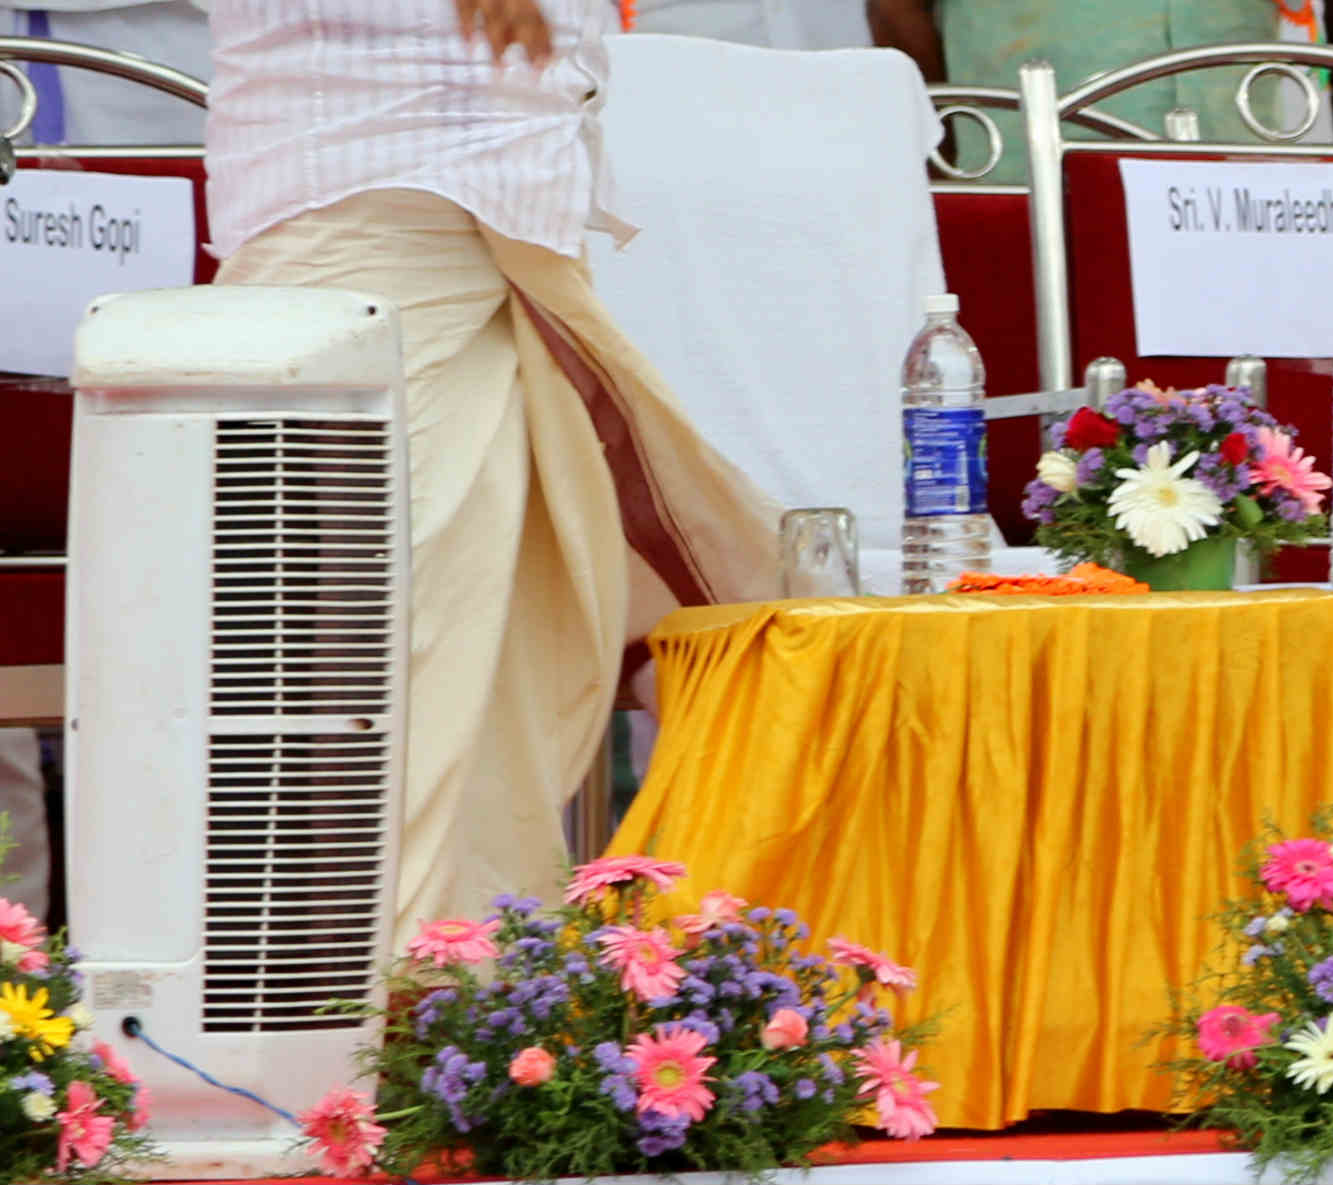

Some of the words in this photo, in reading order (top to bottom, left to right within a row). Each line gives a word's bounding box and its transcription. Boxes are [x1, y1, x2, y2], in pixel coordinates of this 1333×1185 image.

[6, 197, 82, 248] Suresh
[89, 204, 140, 266] Gopi
[1168, 187, 1204, 232] Sri.
[1207, 187, 1230, 232] V.
